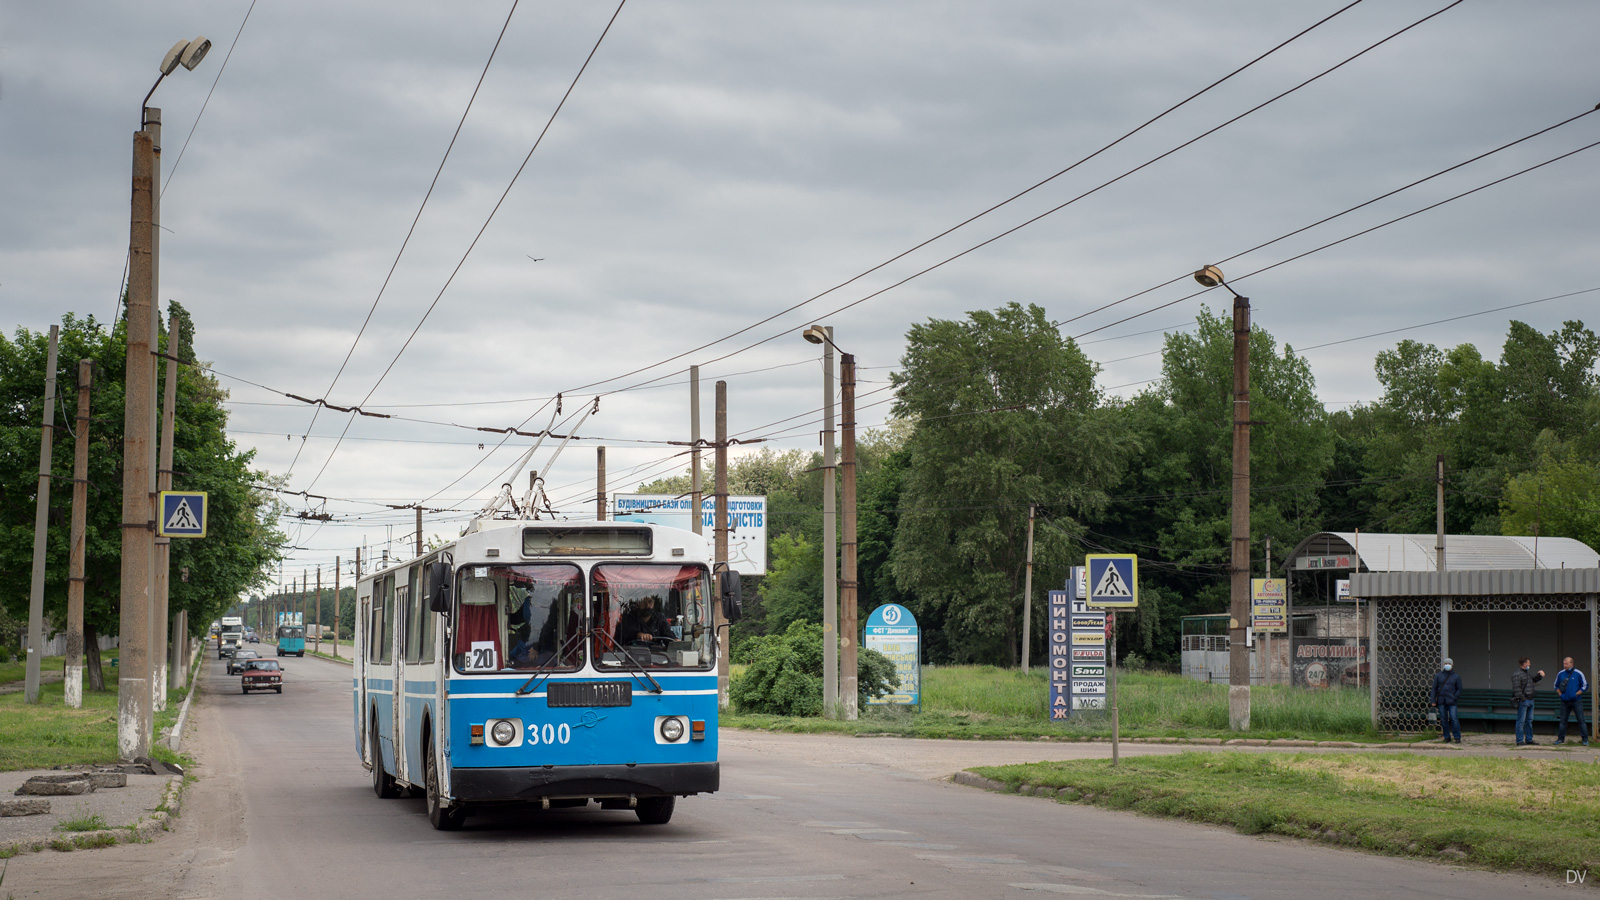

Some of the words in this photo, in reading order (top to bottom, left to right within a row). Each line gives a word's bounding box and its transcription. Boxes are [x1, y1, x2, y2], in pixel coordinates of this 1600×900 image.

[1336, 557, 1349, 567] 24h
[1297, 644, 1366, 657] АВТОМИЙКА
[473, 648, 494, 668] 20
[1053, 594, 1067, 719] ШИНОМОНТАЖ
[1075, 667, 1103, 675] Sava
[1308, 671, 1325, 679] 24/7
[1080, 699, 1098, 707] WC
[527, 723, 571, 745] 300
